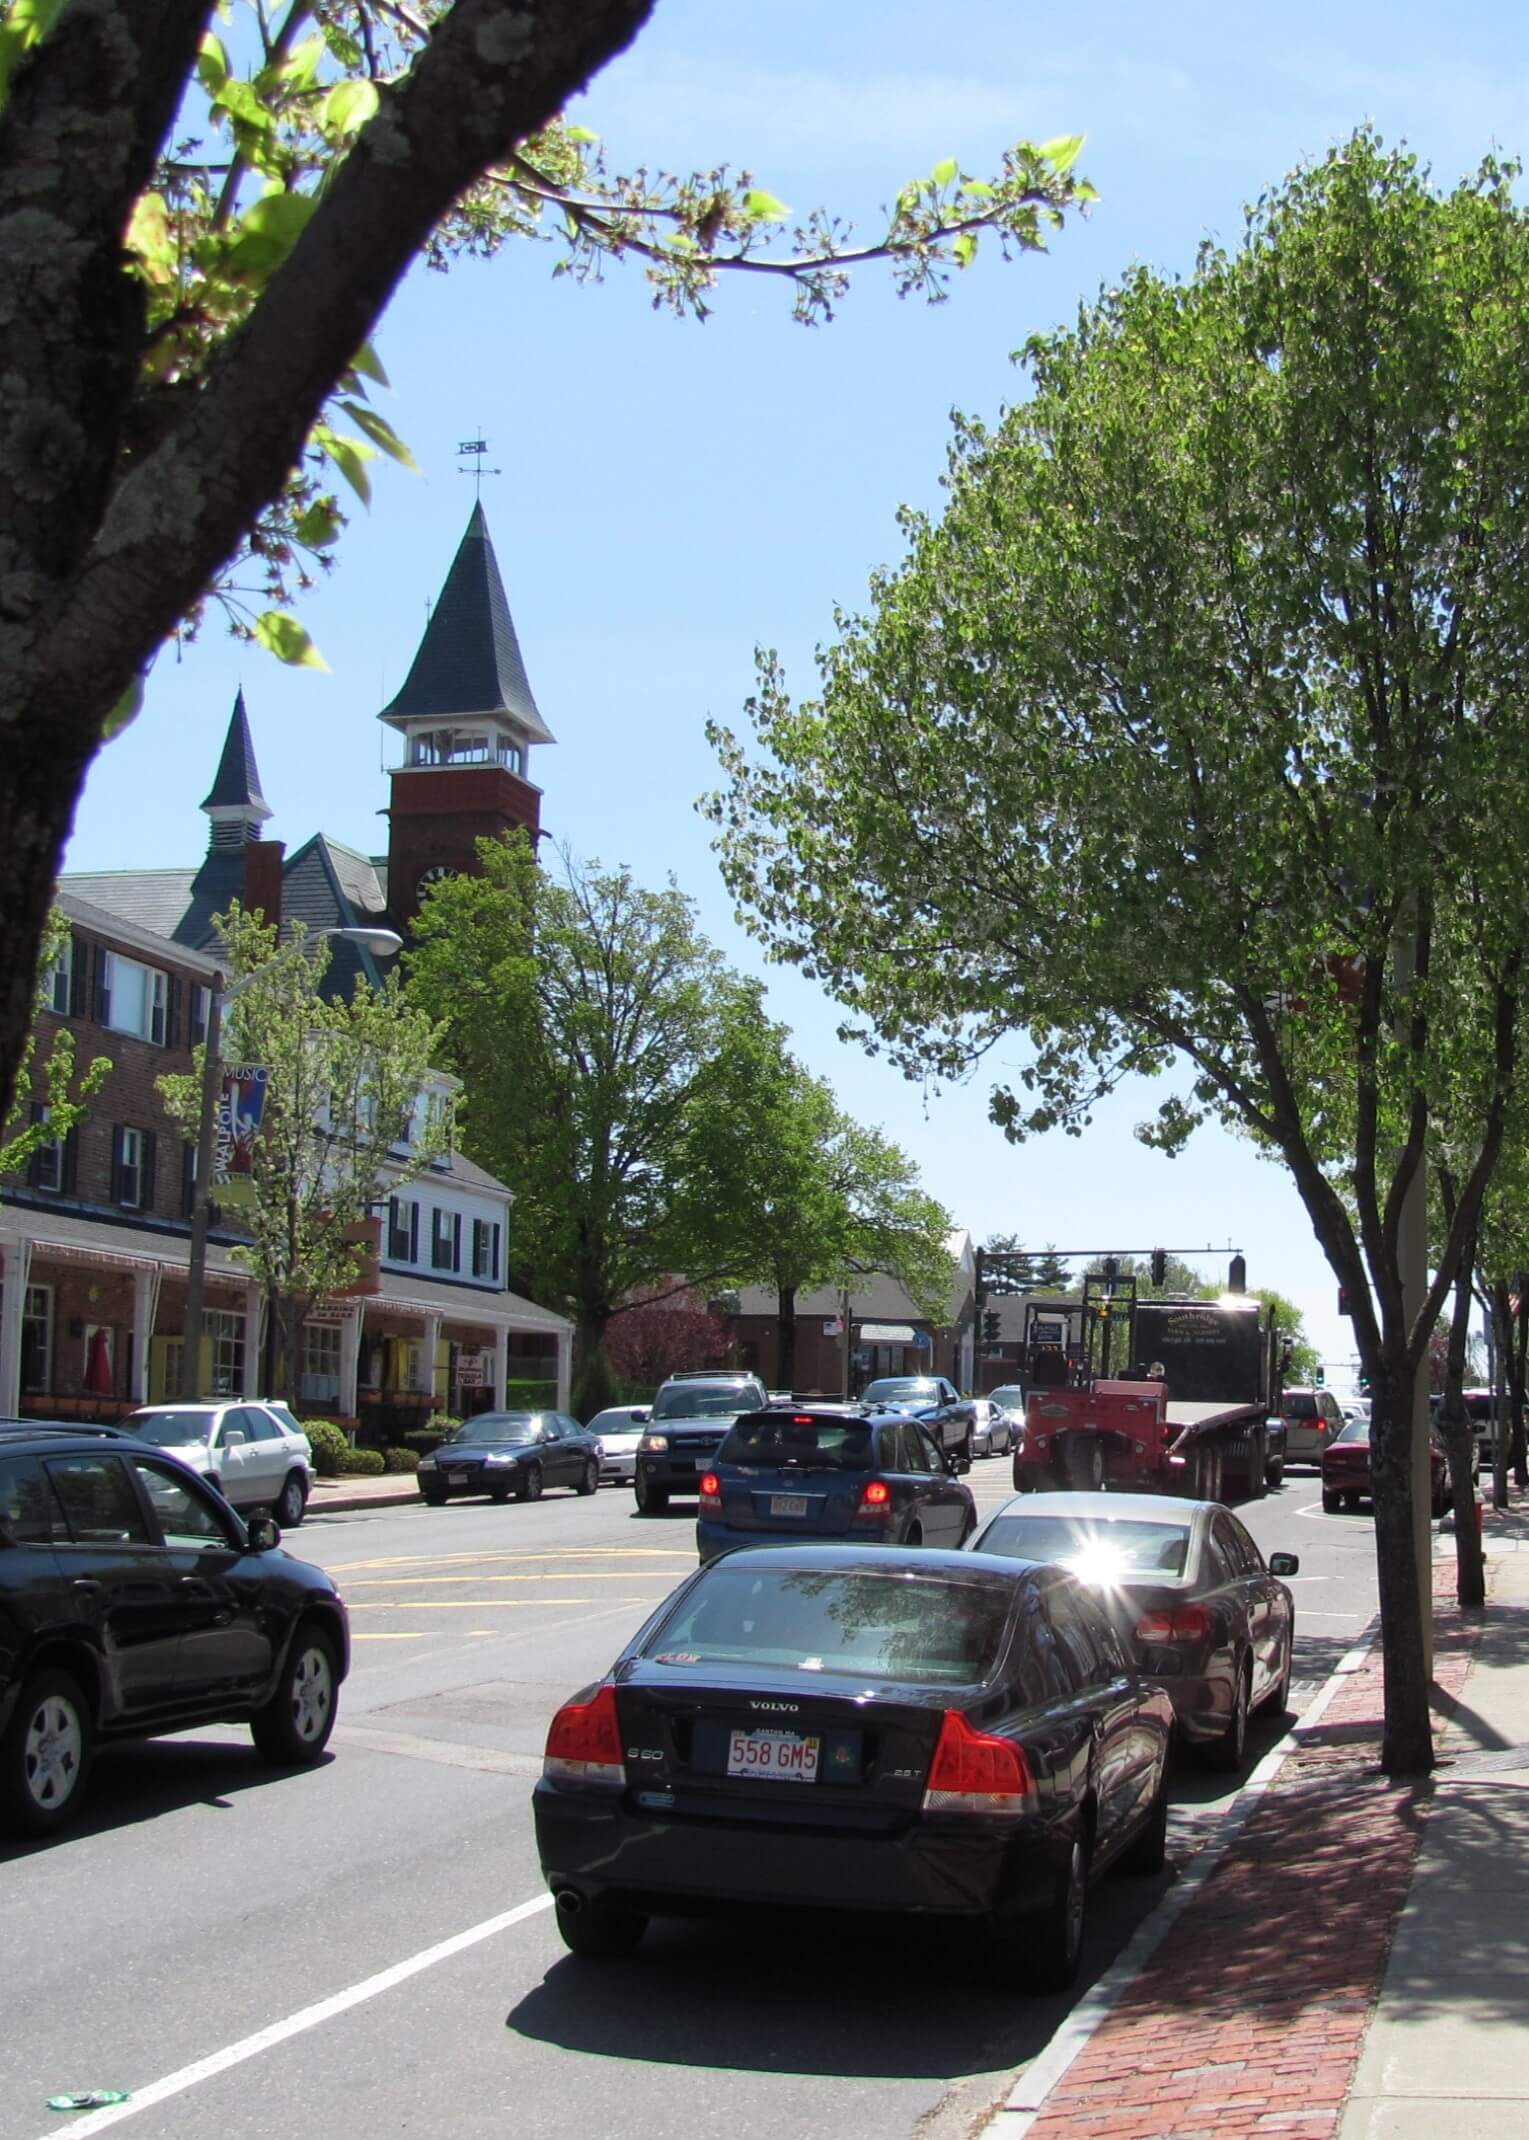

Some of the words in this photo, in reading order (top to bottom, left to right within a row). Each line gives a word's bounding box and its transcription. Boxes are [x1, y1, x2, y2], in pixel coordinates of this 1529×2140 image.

[224, 1064, 268, 1083] MUSIC
[215, 1093, 233, 1172] WALPOLE
[750, 1700, 799, 1712] VOLVO
[627, 1747, 665, 1760] S60
[732, 1738, 772, 1765] 558
[777, 1743, 816, 1769] GM5
